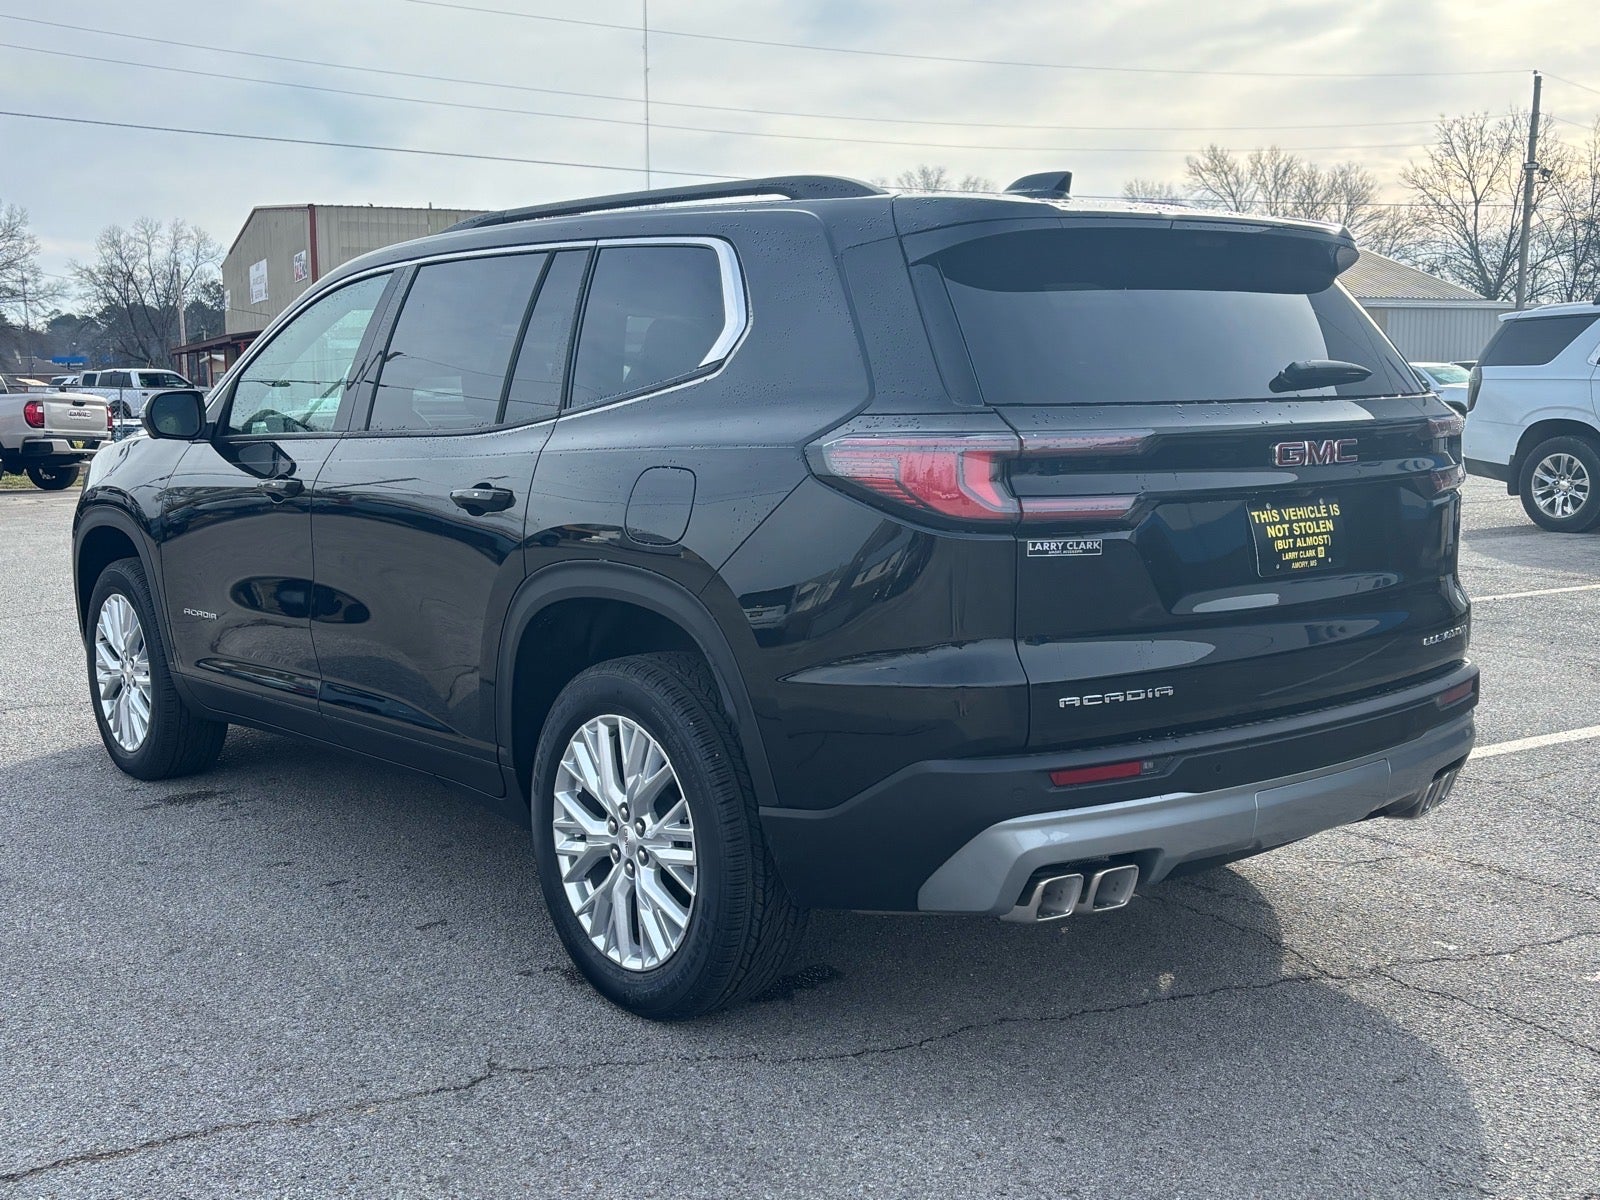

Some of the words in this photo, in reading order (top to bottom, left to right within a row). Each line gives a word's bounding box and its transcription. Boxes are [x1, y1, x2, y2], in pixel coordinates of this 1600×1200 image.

[1274, 438, 1358, 467] GMC
[1251, 509, 1280, 524] THIS
[1281, 504, 1328, 521] VEHICLE
[1329, 503, 1341, 516] IS
[1266, 523, 1290, 538] NOT
[1292, 519, 1334, 535] STOLEN
[1029, 542, 1064, 551] LARRY
[1066, 541, 1101, 550] CLARK
[1274, 538, 1294, 552] (BUT
[1296, 534, 1332, 547] ALMOST)
[1282, 551, 1298, 560] LARRY
[1299, 549, 1317, 558] CLARK
[183, 607, 217, 620] ACADIA
[1059, 686, 1174, 708] ACADIA
